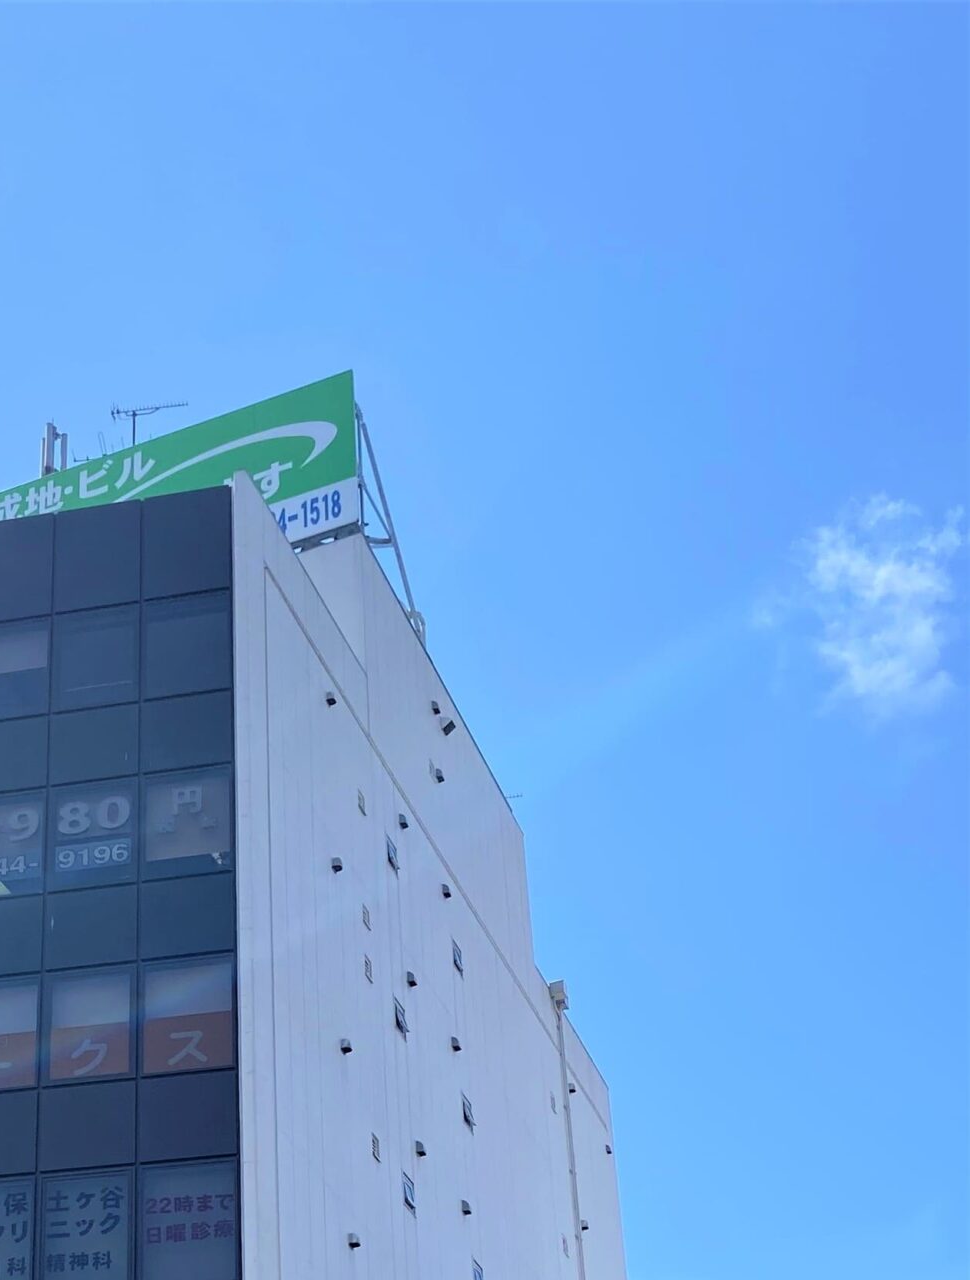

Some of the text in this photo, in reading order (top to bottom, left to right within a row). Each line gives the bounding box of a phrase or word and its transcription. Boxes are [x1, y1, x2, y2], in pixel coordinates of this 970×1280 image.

[271, 489, 342, 532] 4-1518
[145, 1193, 234, 1215] 22時まで
[146, 1219, 235, 1244] 日曜診療
[45, 1251, 113, 1273] 精神科
